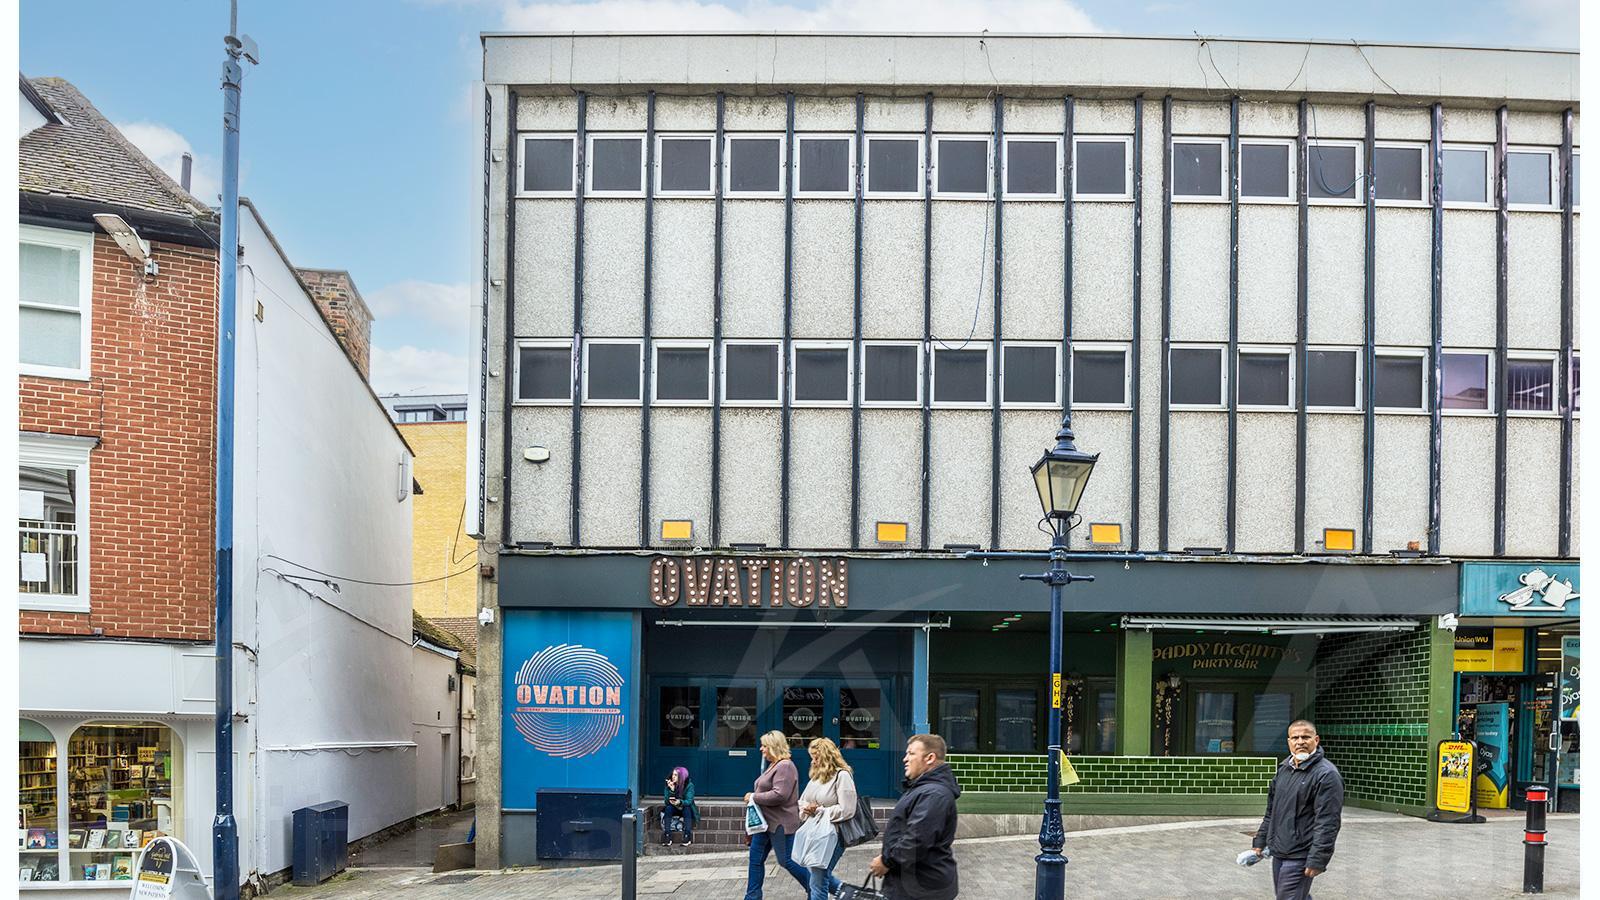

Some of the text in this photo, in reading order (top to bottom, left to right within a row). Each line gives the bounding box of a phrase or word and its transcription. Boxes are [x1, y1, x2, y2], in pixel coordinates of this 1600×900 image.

[650, 557, 848, 608] OVATION
[1152, 643, 1210, 662] PADDY
[1193, 655, 1259, 669] PARTY BAR
[516, 684, 621, 706] OVATION
[1480, 748, 1493, 758] Dyas
